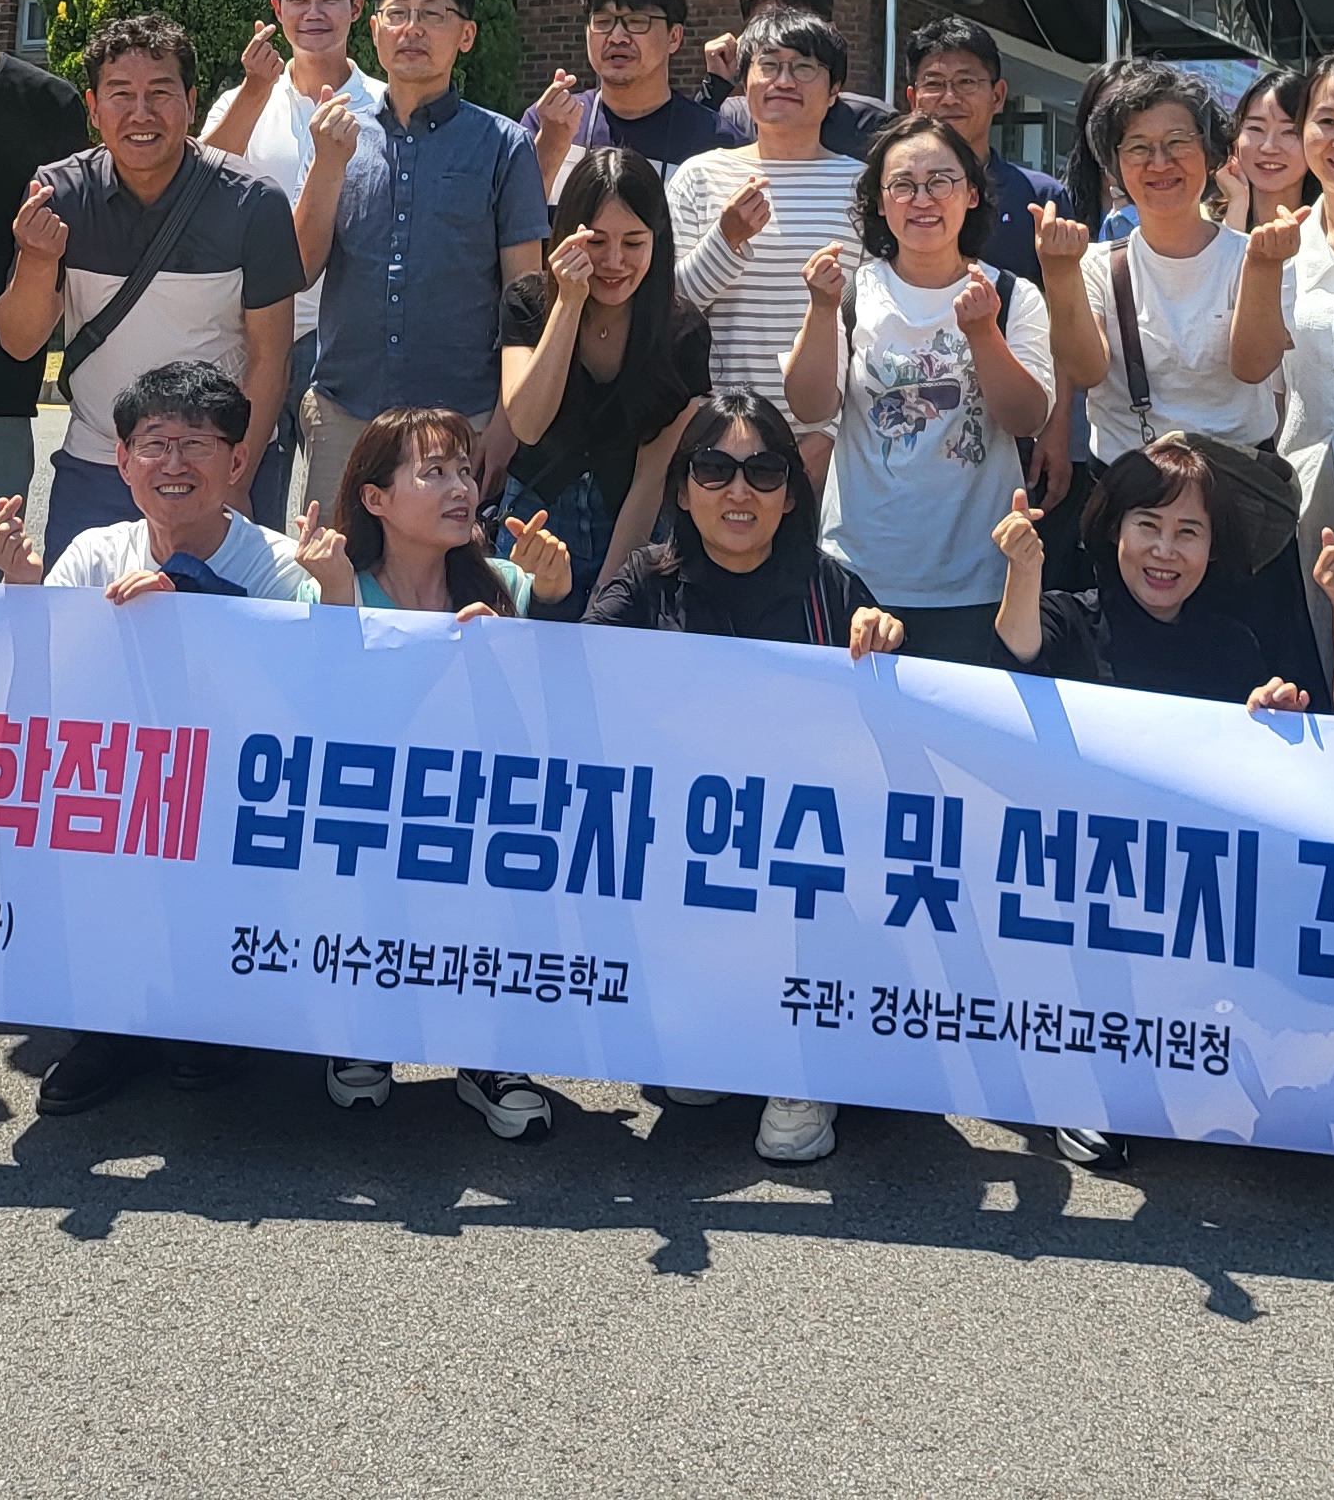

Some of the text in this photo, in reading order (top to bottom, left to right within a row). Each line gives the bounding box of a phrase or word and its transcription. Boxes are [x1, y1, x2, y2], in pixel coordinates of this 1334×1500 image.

[231, 733, 656, 902] 업무담당자
[683, 774, 846, 921] 연수
[883, 791, 964, 934] 및
[995, 806, 1260, 970] 선진지
[230, 925, 629, 1007] 장소: 여수정보과학고등학교
[780, 976, 1230, 1076] 주관: 경상남도사천교육지원청
